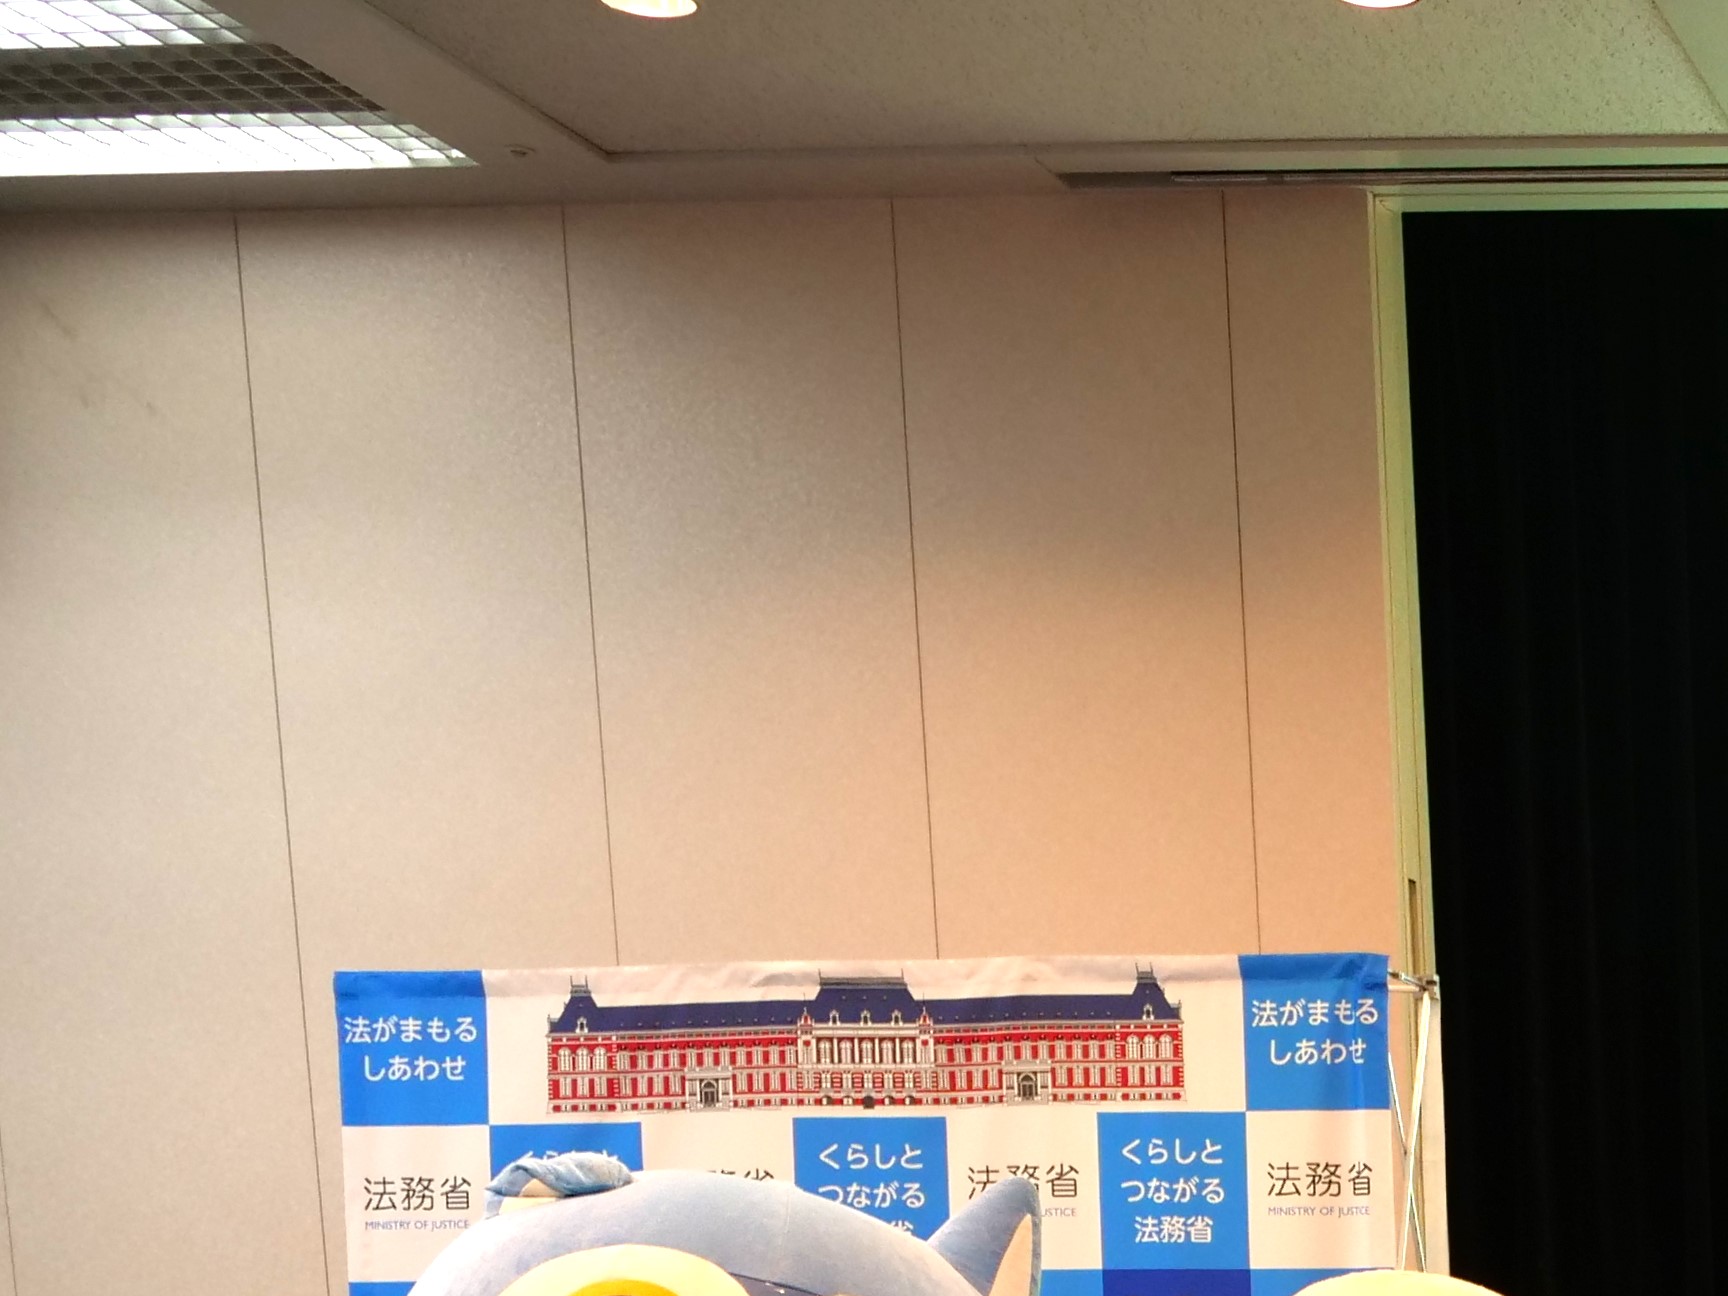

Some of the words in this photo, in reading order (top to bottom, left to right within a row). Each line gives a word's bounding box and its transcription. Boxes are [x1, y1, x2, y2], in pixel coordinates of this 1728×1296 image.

[1251, 999, 1379, 1028] 法がまもる
[344, 1016, 477, 1043] 法がまもる
[1270, 1039, 1367, 1065] しあわせ
[363, 1055, 466, 1081] しあわせ
[819, 1144, 923, 1169] くらしと
[1121, 1139, 1223, 1164] くらしと
[1121, 1178, 1225, 1203] つながる
[1267, 1162, 1372, 1197] 法務省
[364, 1176, 472, 1212] 法務省
[818, 1182, 925, 1208] つながる
[1268, 1206, 1316, 1216] MINISTRY
[1320, 1206, 1334, 1216] OF
[365, 1220, 411, 1230] MINISTRY
[414, 1220, 428, 1230] OF
[431, 1220, 470, 1232] JUSTICE
[1134, 1216, 1213, 1243] 法務省
